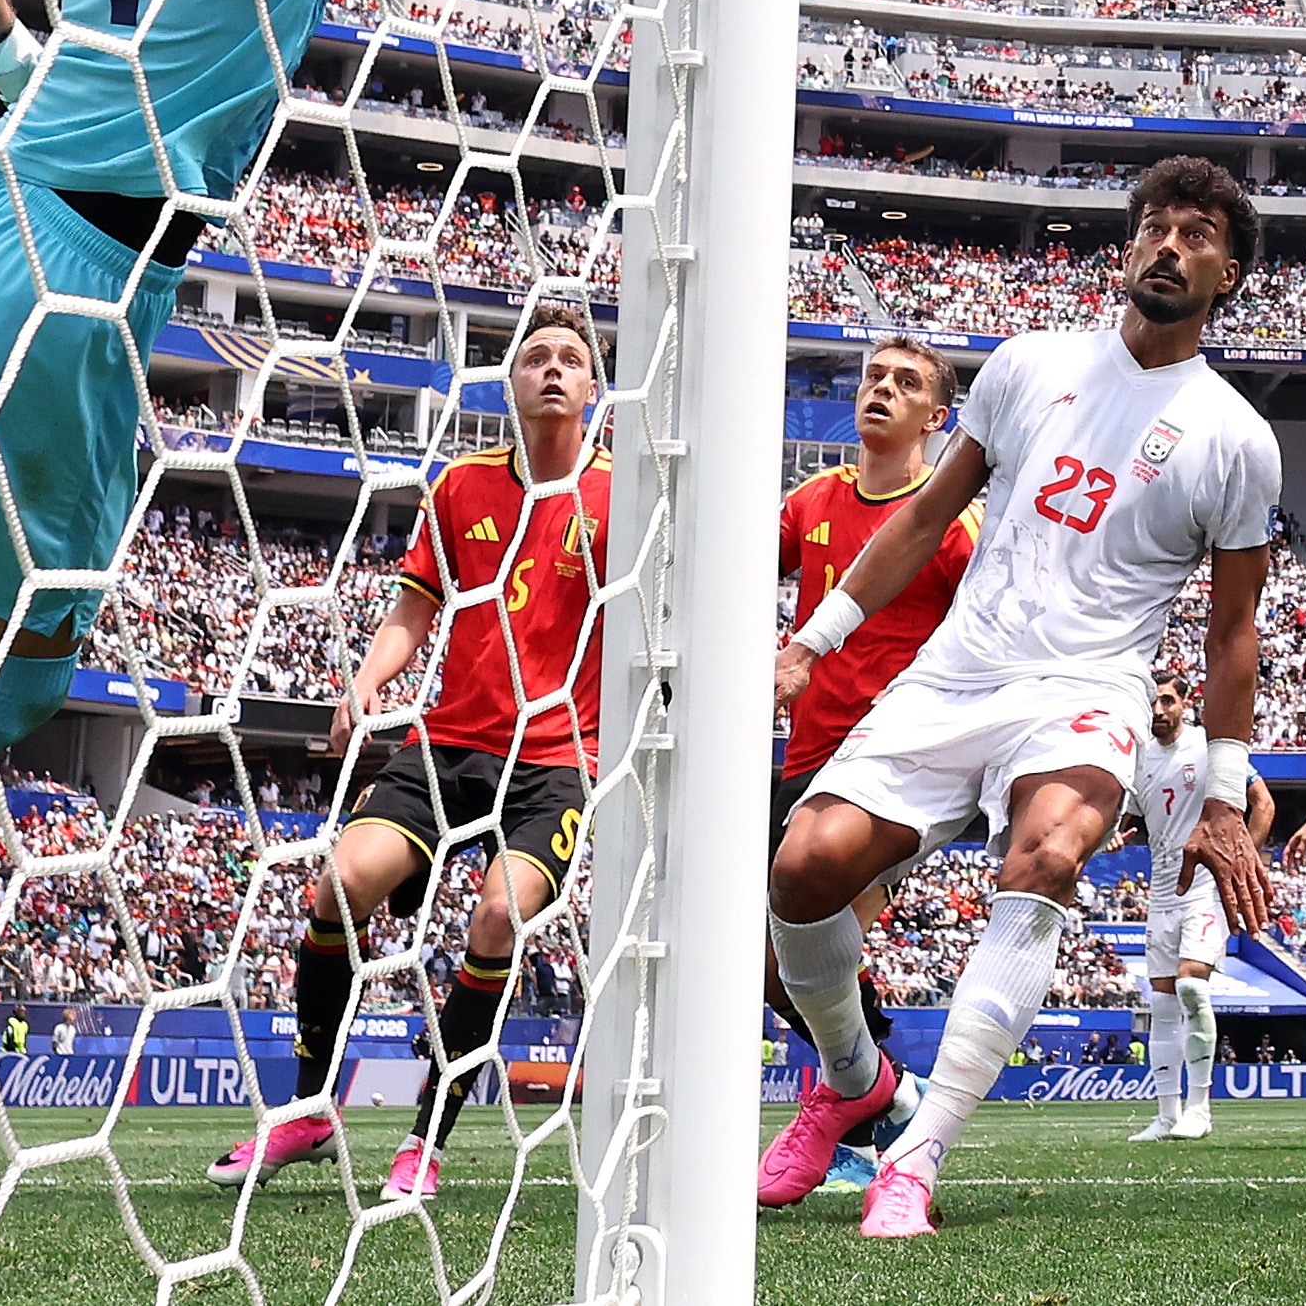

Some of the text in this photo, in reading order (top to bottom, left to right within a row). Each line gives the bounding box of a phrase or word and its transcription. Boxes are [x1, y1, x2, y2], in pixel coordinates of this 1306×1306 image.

[1013, 111, 1134, 128] FIFA WORLD CUP 2026
[842, 327, 867, 339] FIFA
[1224, 349, 1302, 361] LOS ANGELES
[1034, 455, 1117, 534] 23
[507, 557, 535, 612] 5
[1162, 788, 1176, 815] 7
[367, 1019, 408, 1037] 2026
[529, 1045, 568, 1064] FIFA
[1029, 1064, 1157, 1101] Michelo
